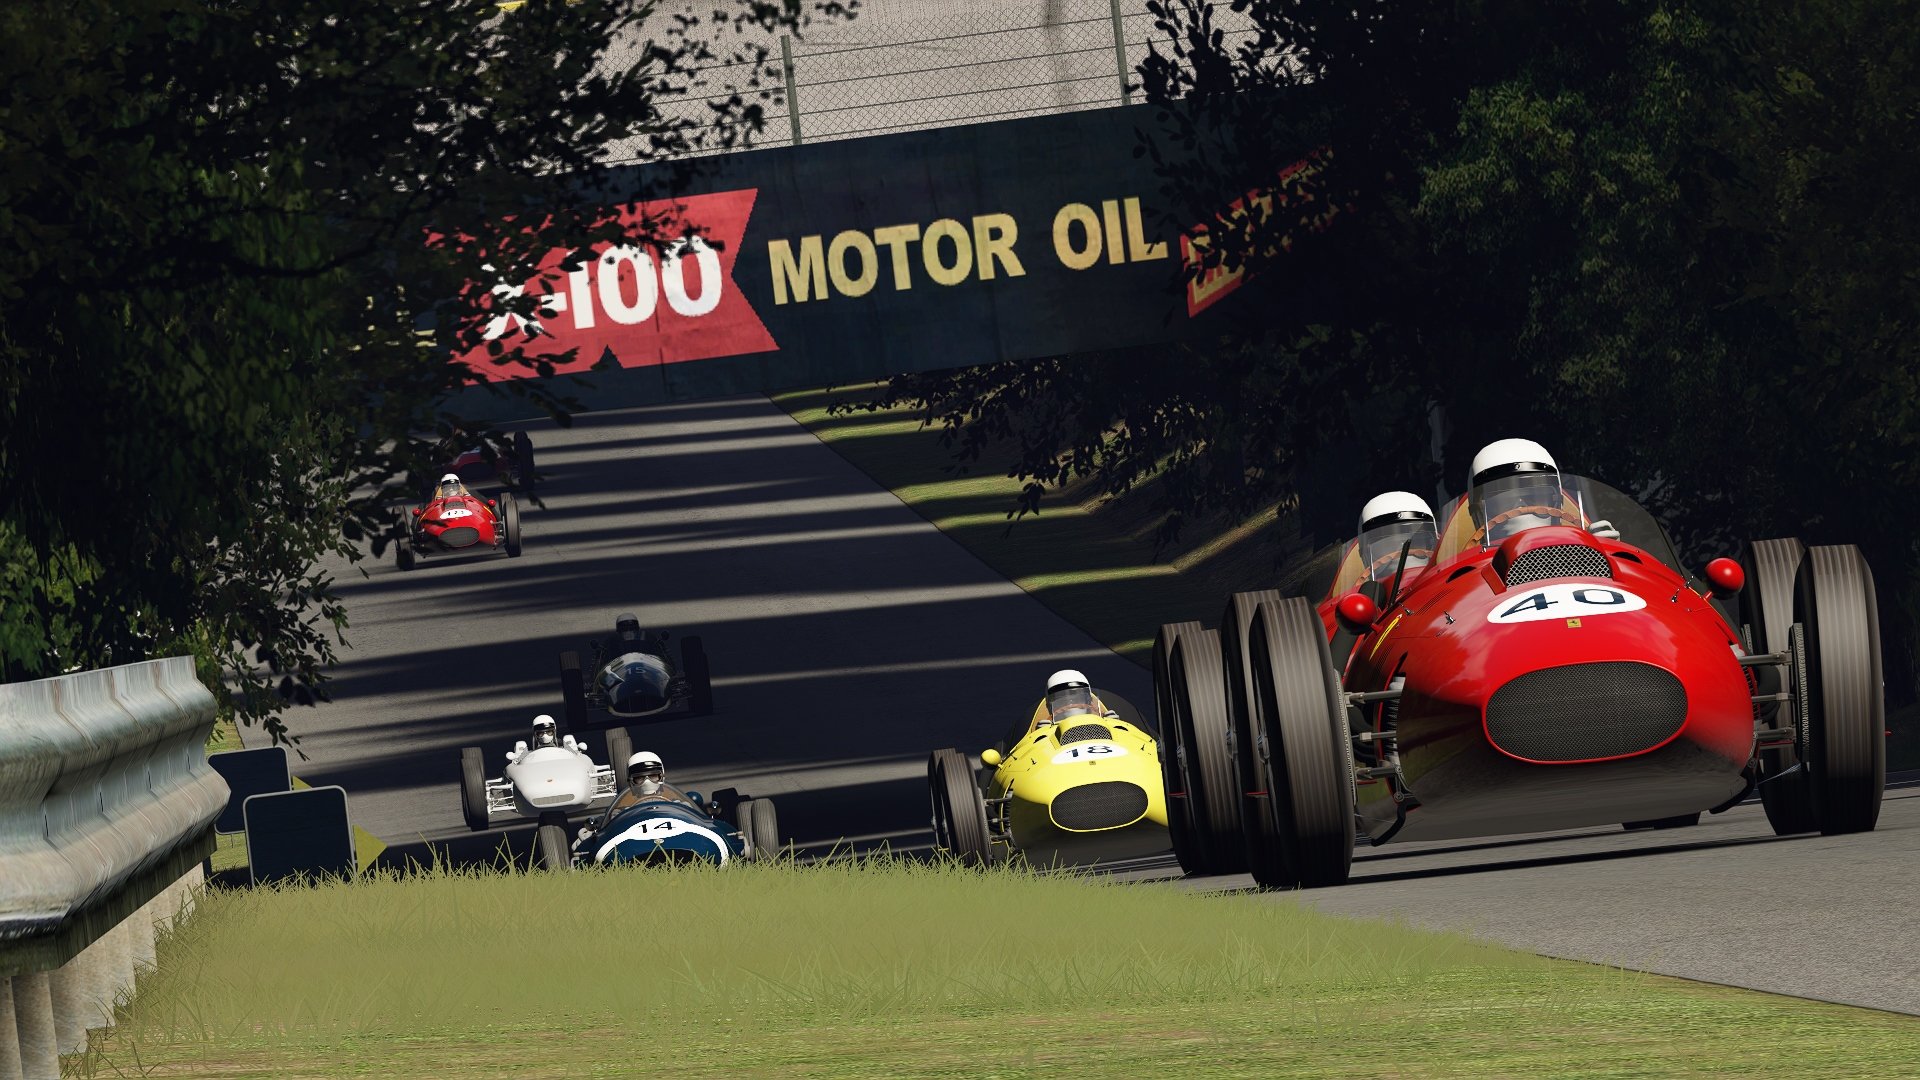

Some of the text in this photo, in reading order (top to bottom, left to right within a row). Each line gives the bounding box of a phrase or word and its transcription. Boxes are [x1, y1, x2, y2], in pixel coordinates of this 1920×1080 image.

[768, 212, 1025, 305] MOTOR
[1053, 197, 1168, 271] OIL
[1500, 588, 1626, 618] 40
[1066, 745, 1113, 757] 18
[638, 821, 676, 833] 14
